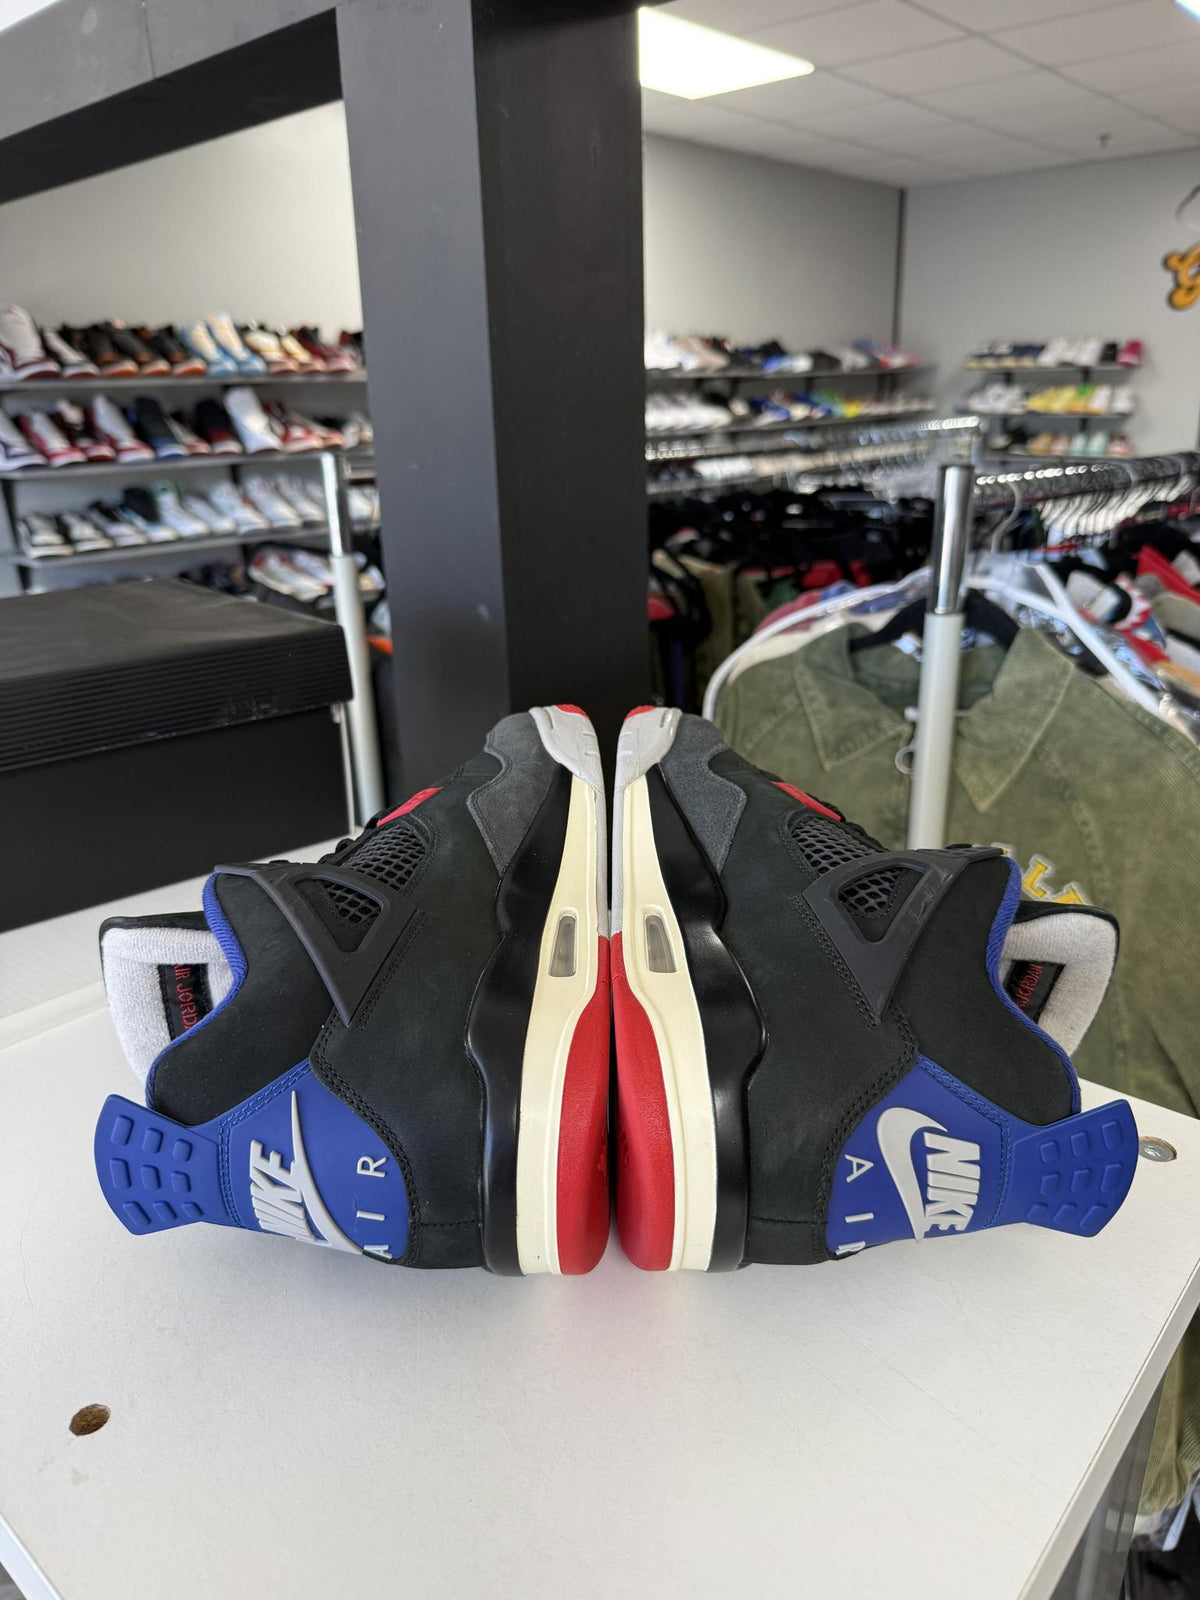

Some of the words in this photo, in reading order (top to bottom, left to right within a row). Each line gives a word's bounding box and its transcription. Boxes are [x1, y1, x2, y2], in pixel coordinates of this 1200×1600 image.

[250, 1139, 318, 1242] NIKE
[356, 1156, 393, 1259] AIR
[923, 1131, 981, 1232] NIKE
